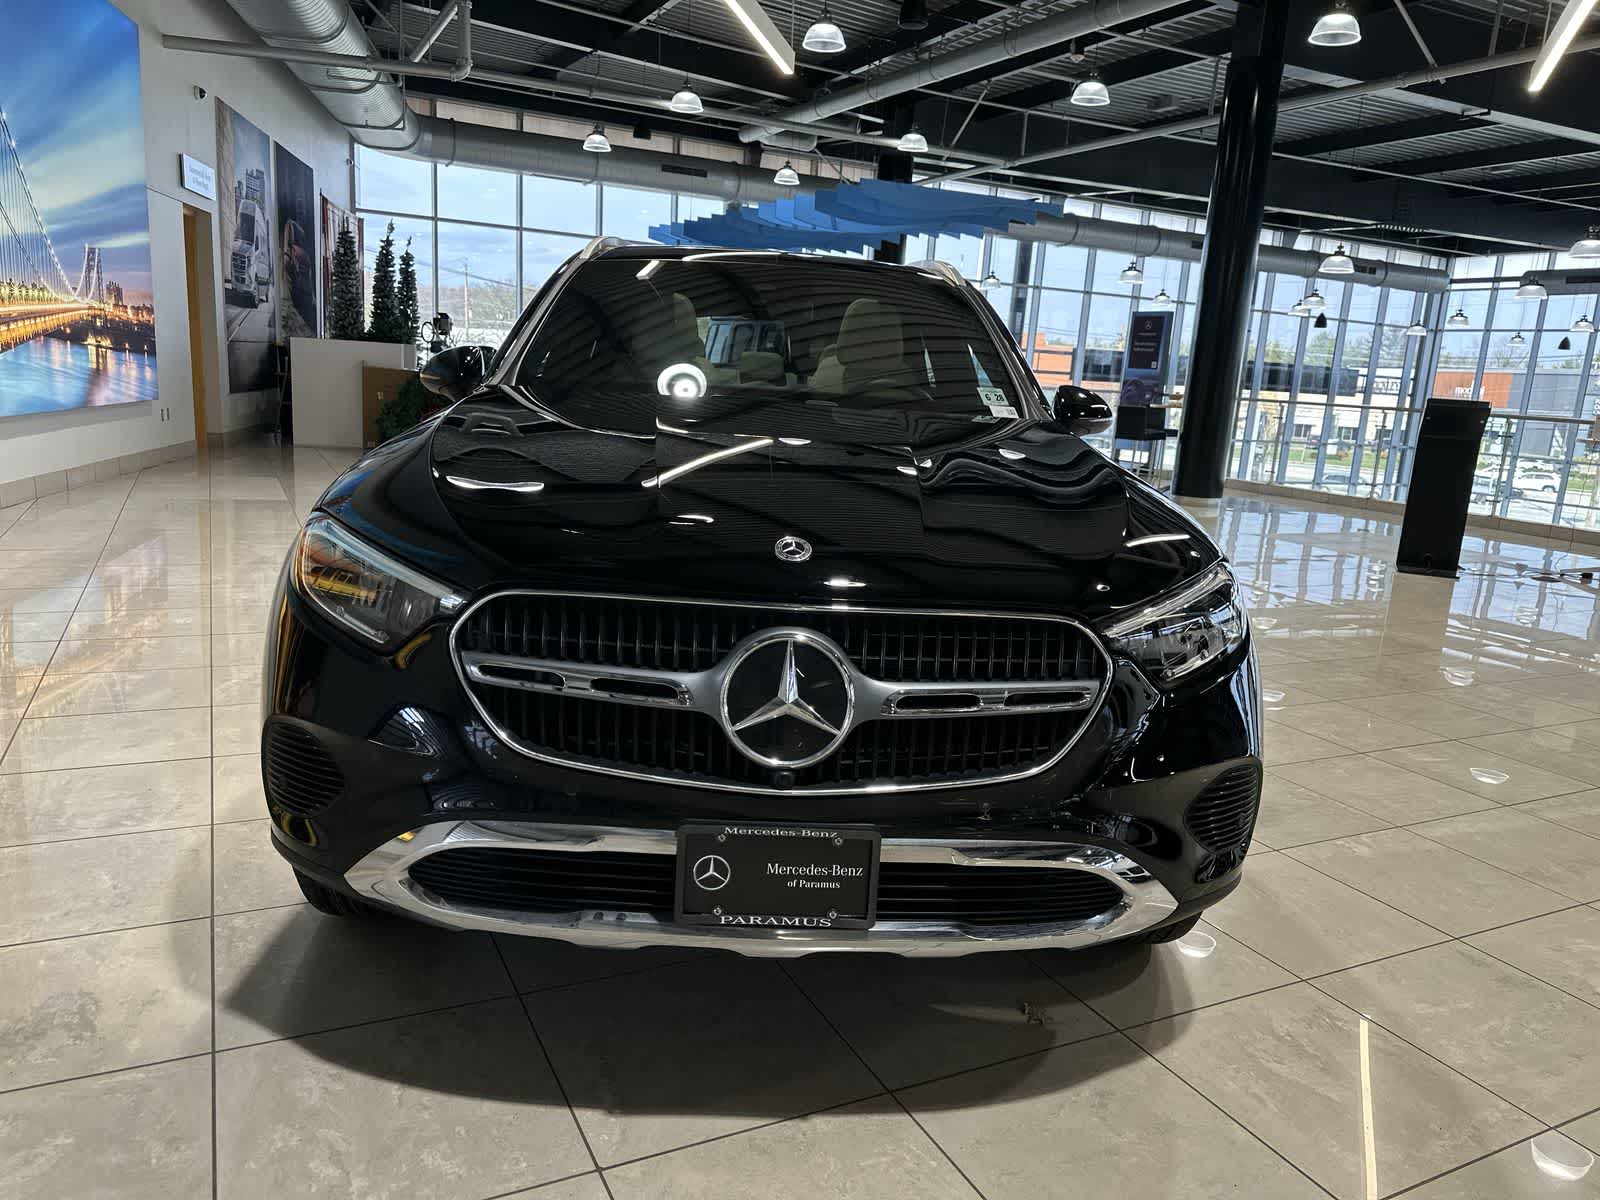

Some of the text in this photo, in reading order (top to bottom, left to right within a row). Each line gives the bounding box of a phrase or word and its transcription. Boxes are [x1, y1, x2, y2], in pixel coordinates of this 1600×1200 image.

[724, 826, 838, 838] Mercedes-Benz
[766, 863, 864, 877] Mercedes-Benz
[787, 879, 841, 889] of Paramus
[719, 915, 832, 927] PARAMUS
